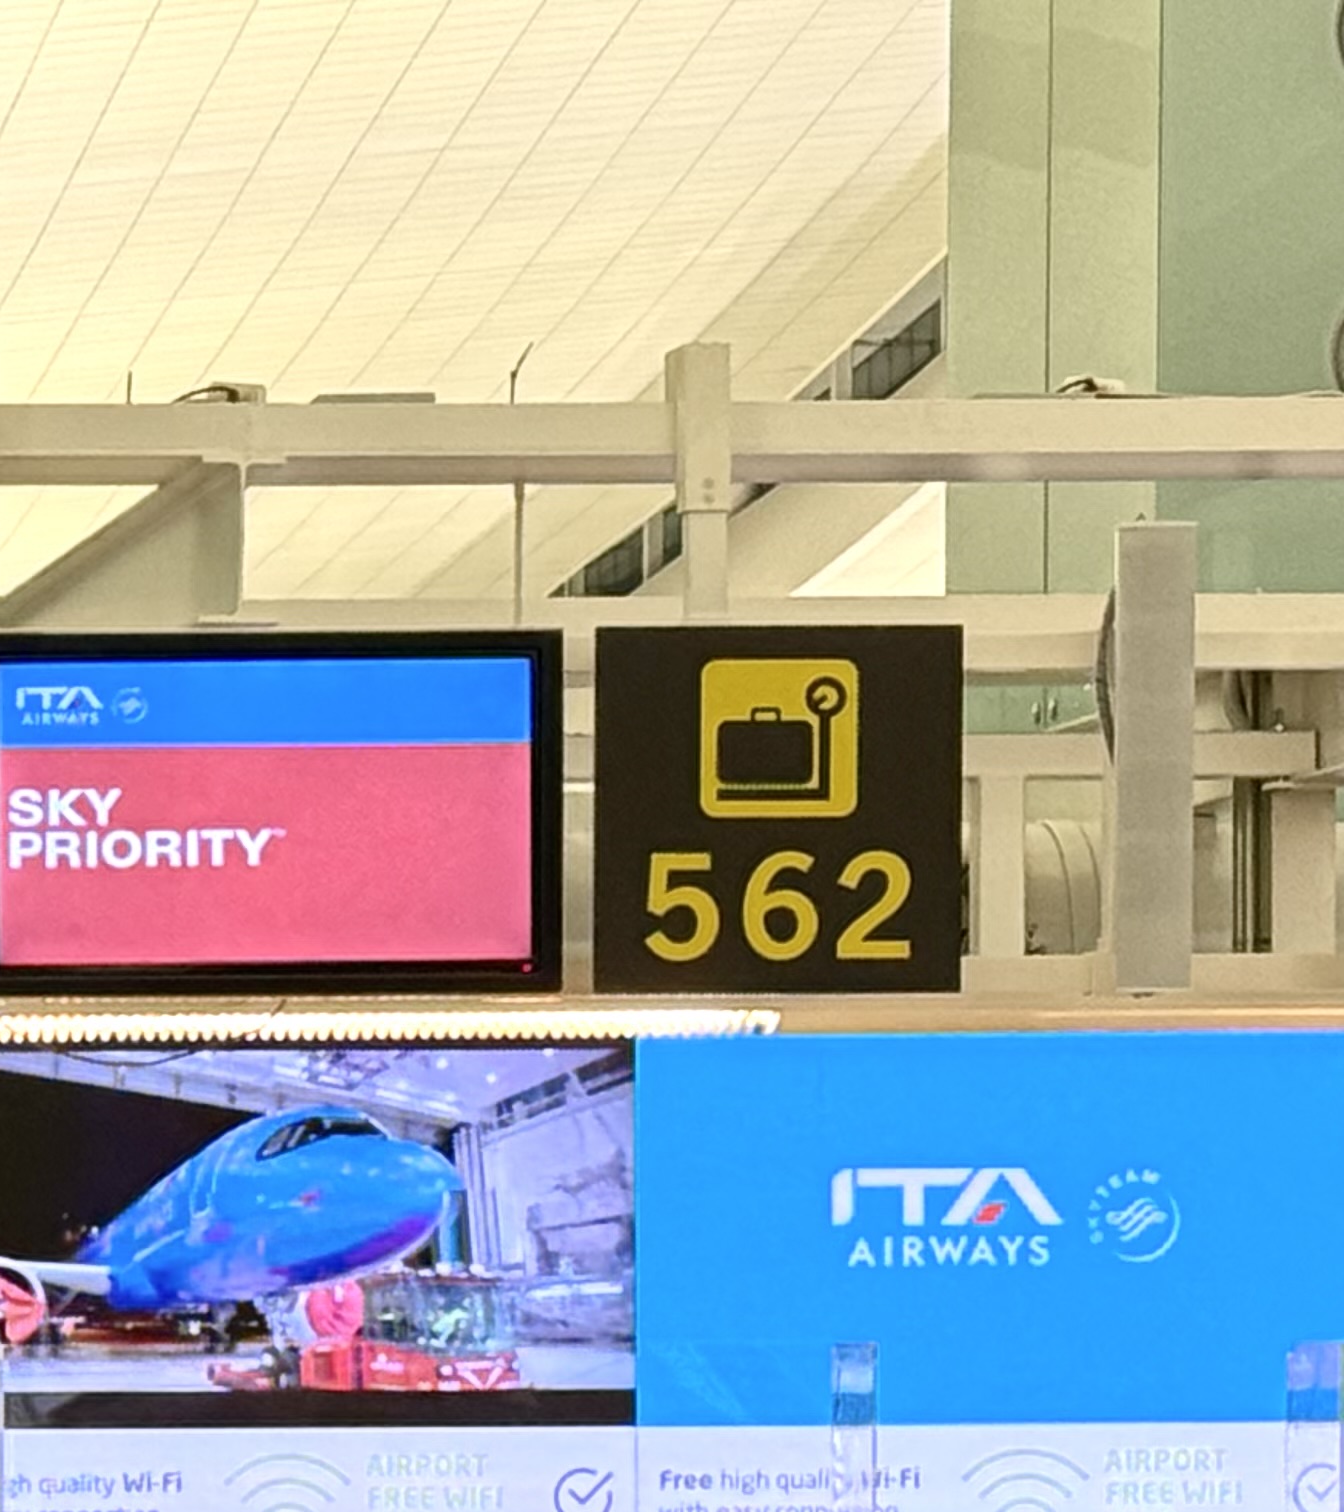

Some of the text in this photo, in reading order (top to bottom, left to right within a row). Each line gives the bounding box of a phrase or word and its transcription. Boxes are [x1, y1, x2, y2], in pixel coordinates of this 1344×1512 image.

[15, 686, 104, 710] ITA
[21, 711, 100, 726] AIRWAYS
[8, 788, 122, 827] SKY
[644, 850, 912, 962] 562
[831, 1168, 1064, 1226] ITA
[848, 1235, 1050, 1268] AIRWAYS
[366, 1453, 489, 1477] AIRPORT
[1104, 1448, 1228, 1472] AIRPORT
[38, 1473, 117, 1499] quality
[122, 1471, 183, 1493] Wi-Fi
[660, 1469, 712, 1491] Free
[720, 1468, 770, 1496] high
[776, 1467, 853, 1498] qualiy
[1105, 1480, 1242, 1505] FREE WIFI
[367, 1486, 503, 1510] FREE WIFI
